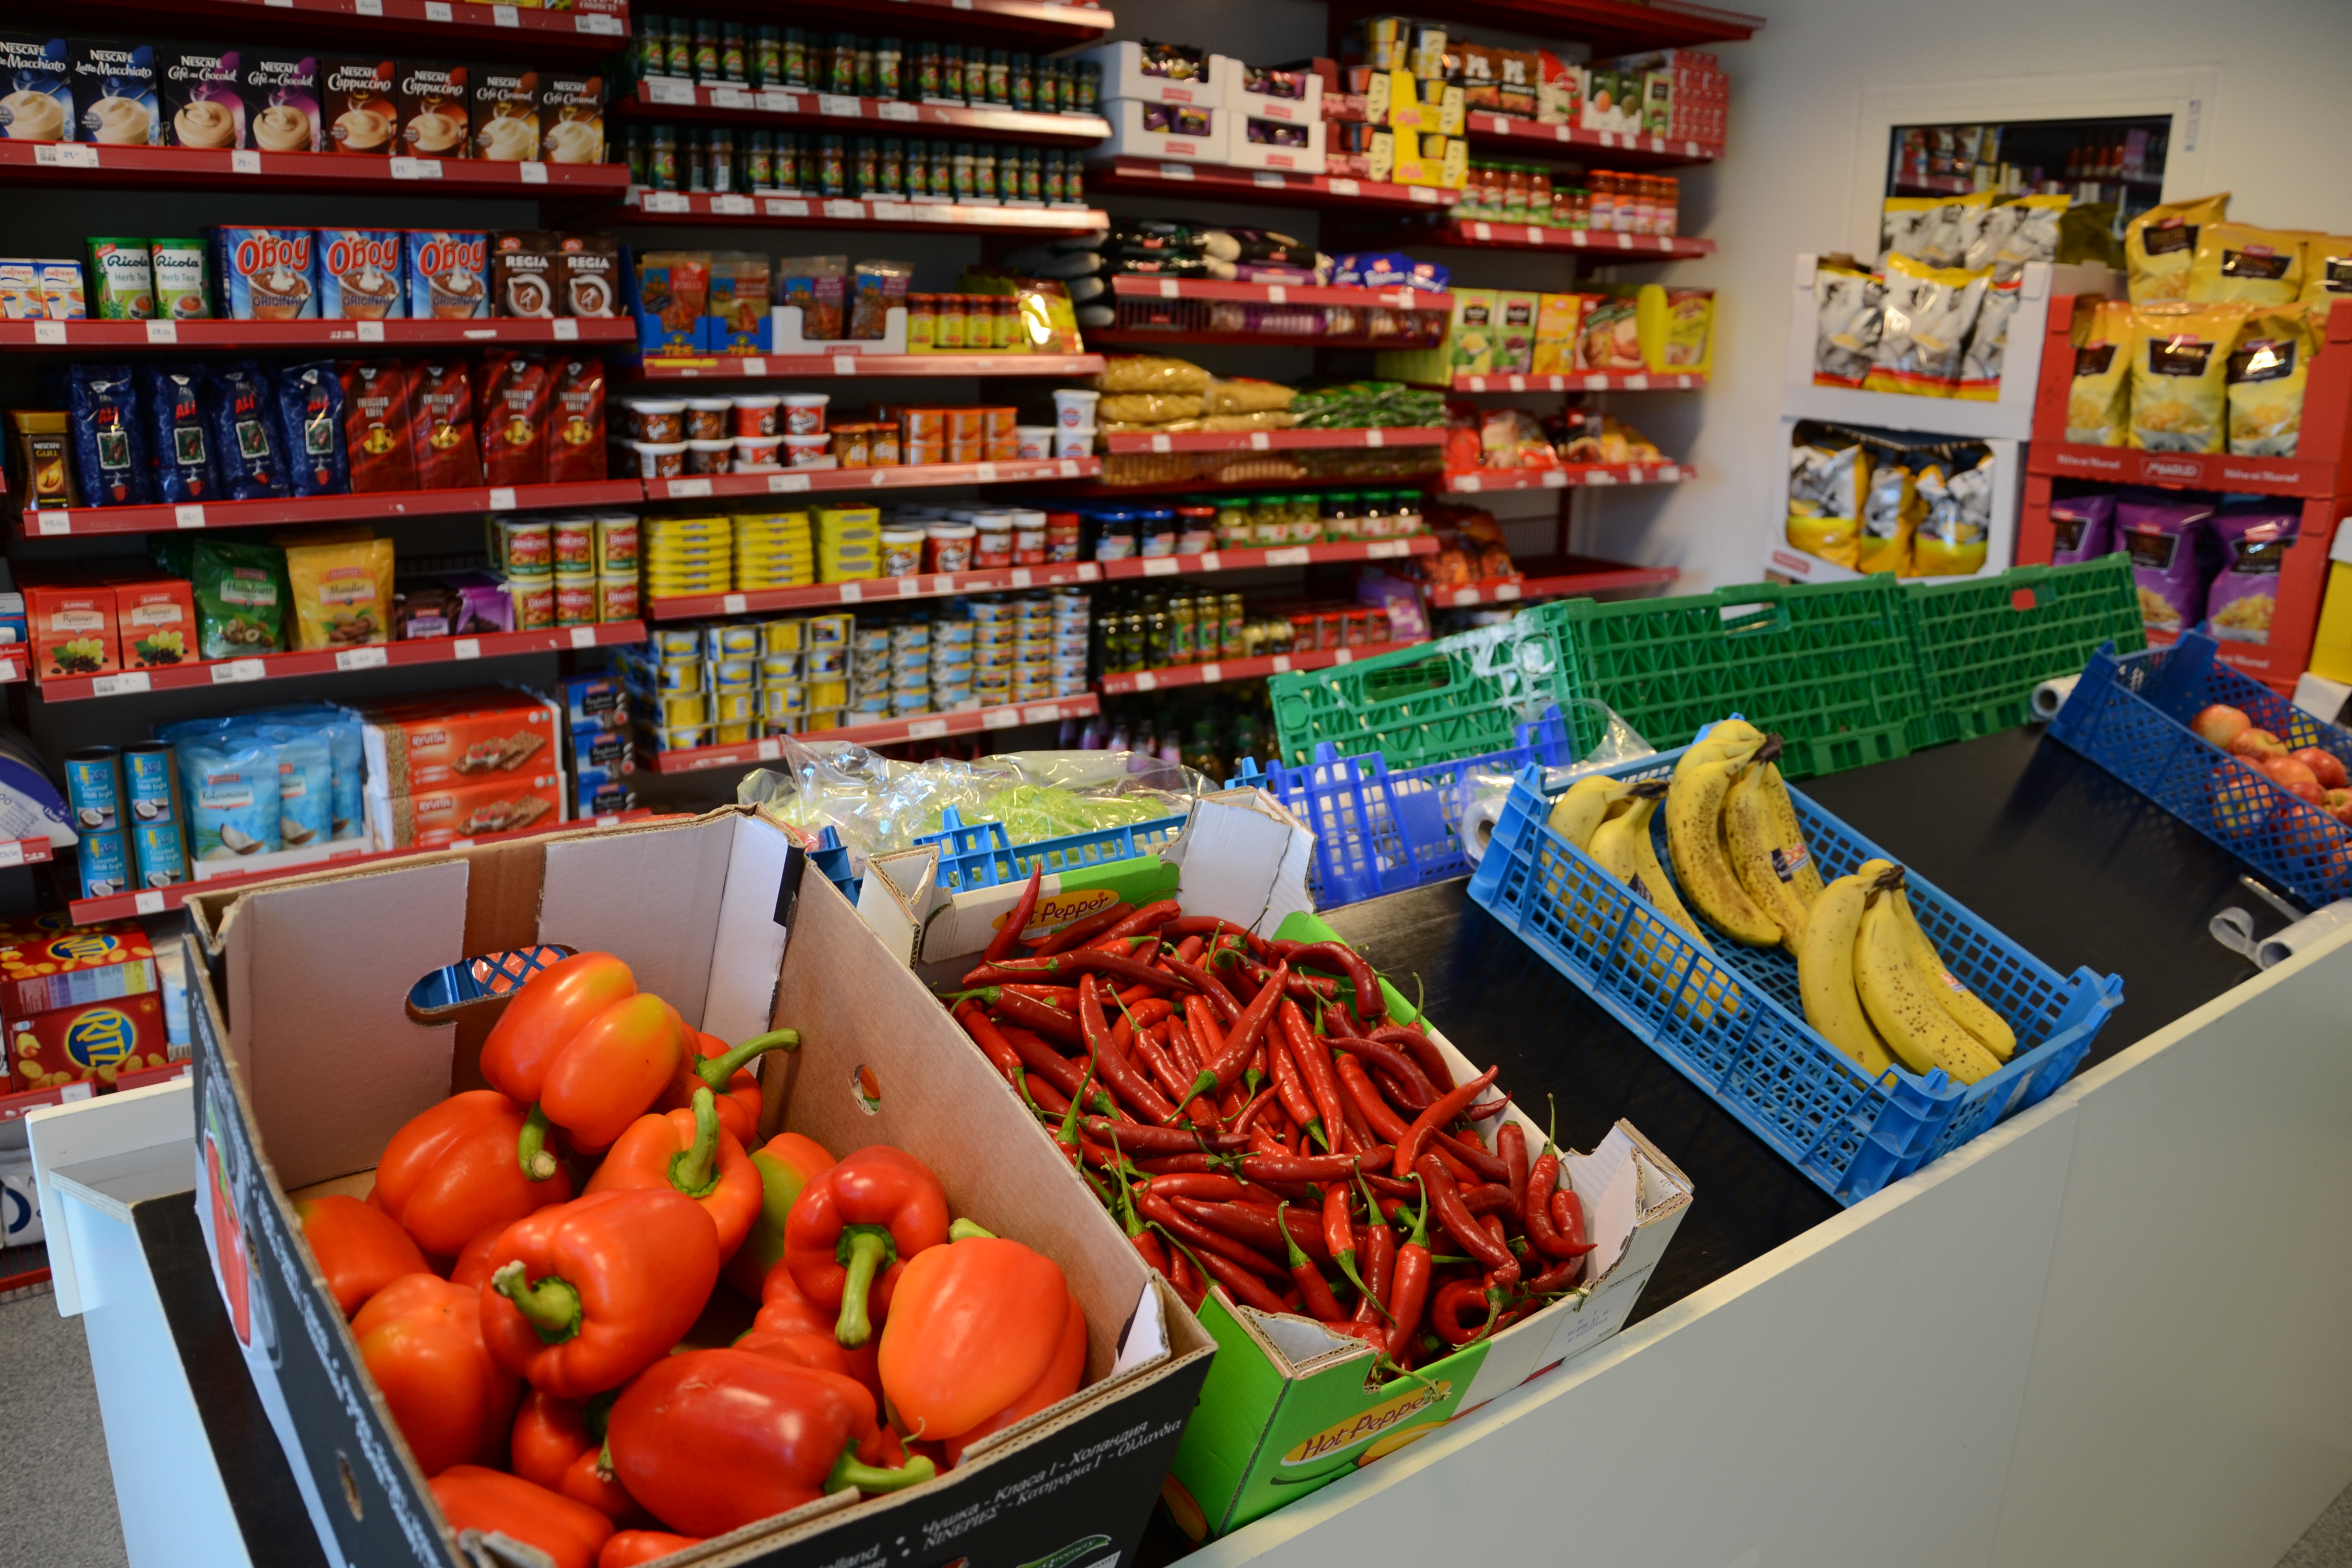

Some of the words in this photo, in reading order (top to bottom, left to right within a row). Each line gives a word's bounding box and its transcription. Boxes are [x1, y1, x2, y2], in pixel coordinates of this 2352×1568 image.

[0, 42, 47, 56] NESCAFÉ
[8, 54, 66, 72] Macchiato
[90, 50, 135, 63] NESCAFÉ
[181, 56, 223, 68] NESCAFÉ
[75, 61, 97, 75] Latte
[97, 62, 152, 78] Macchiato
[168, 65, 189, 81] Café
[199, 67, 238, 82] Chocolat
[260, 61, 300, 74] NESCAFÉ
[340, 66, 378, 78] NESCAFÉ
[248, 71, 268, 86] Café
[277, 72, 314, 87] Chocolat
[328, 72, 391, 92] Cappuccino
[414, 70, 451, 83] NESCAFÉ
[487, 76, 522, 88] NESCAFÉ
[402, 77, 463, 97] Cappuccino
[497, 88, 533, 103] Caramel
[156, 255, 199, 267] Ricola
[234, 234, 311, 276] O'boy
[327, 235, 401, 276] O'boy
[418, 238, 486, 277] O'boy
[505, 255, 550, 268] REGIA
[568, 256, 610, 269] REGIA
[1, 268, 32, 277] natreen
[46, 268, 76, 278] natreen
[115, 273, 135, 281] Herb
[161, 273, 179, 281] Herb
[252, 293, 302, 307] ORIGINAL
[342, 295, 391, 307] ORIGINAL
[175, 400, 197, 420] ALI
[235, 394, 255, 414] ALI
[330, 583, 365, 595] Mandler
[63, 614, 93, 622] Rosiner
[142, 607, 172, 617] Rosiner
[412, 732, 445, 747] RYVITA
[203, 790, 249, 800] Kokosmasse
[419, 798, 452, 812] RYVITA
[1041, 896, 1109, 923] Pepper
[74, 1011, 126, 1067] RITZ
[1300, 1429, 1348, 1461] Hot
[1350, 1398, 1425, 1439] Peppe
[994, 1470, 1045, 1504] Класа
[1069, 1421, 1148, 1466] Холандия
